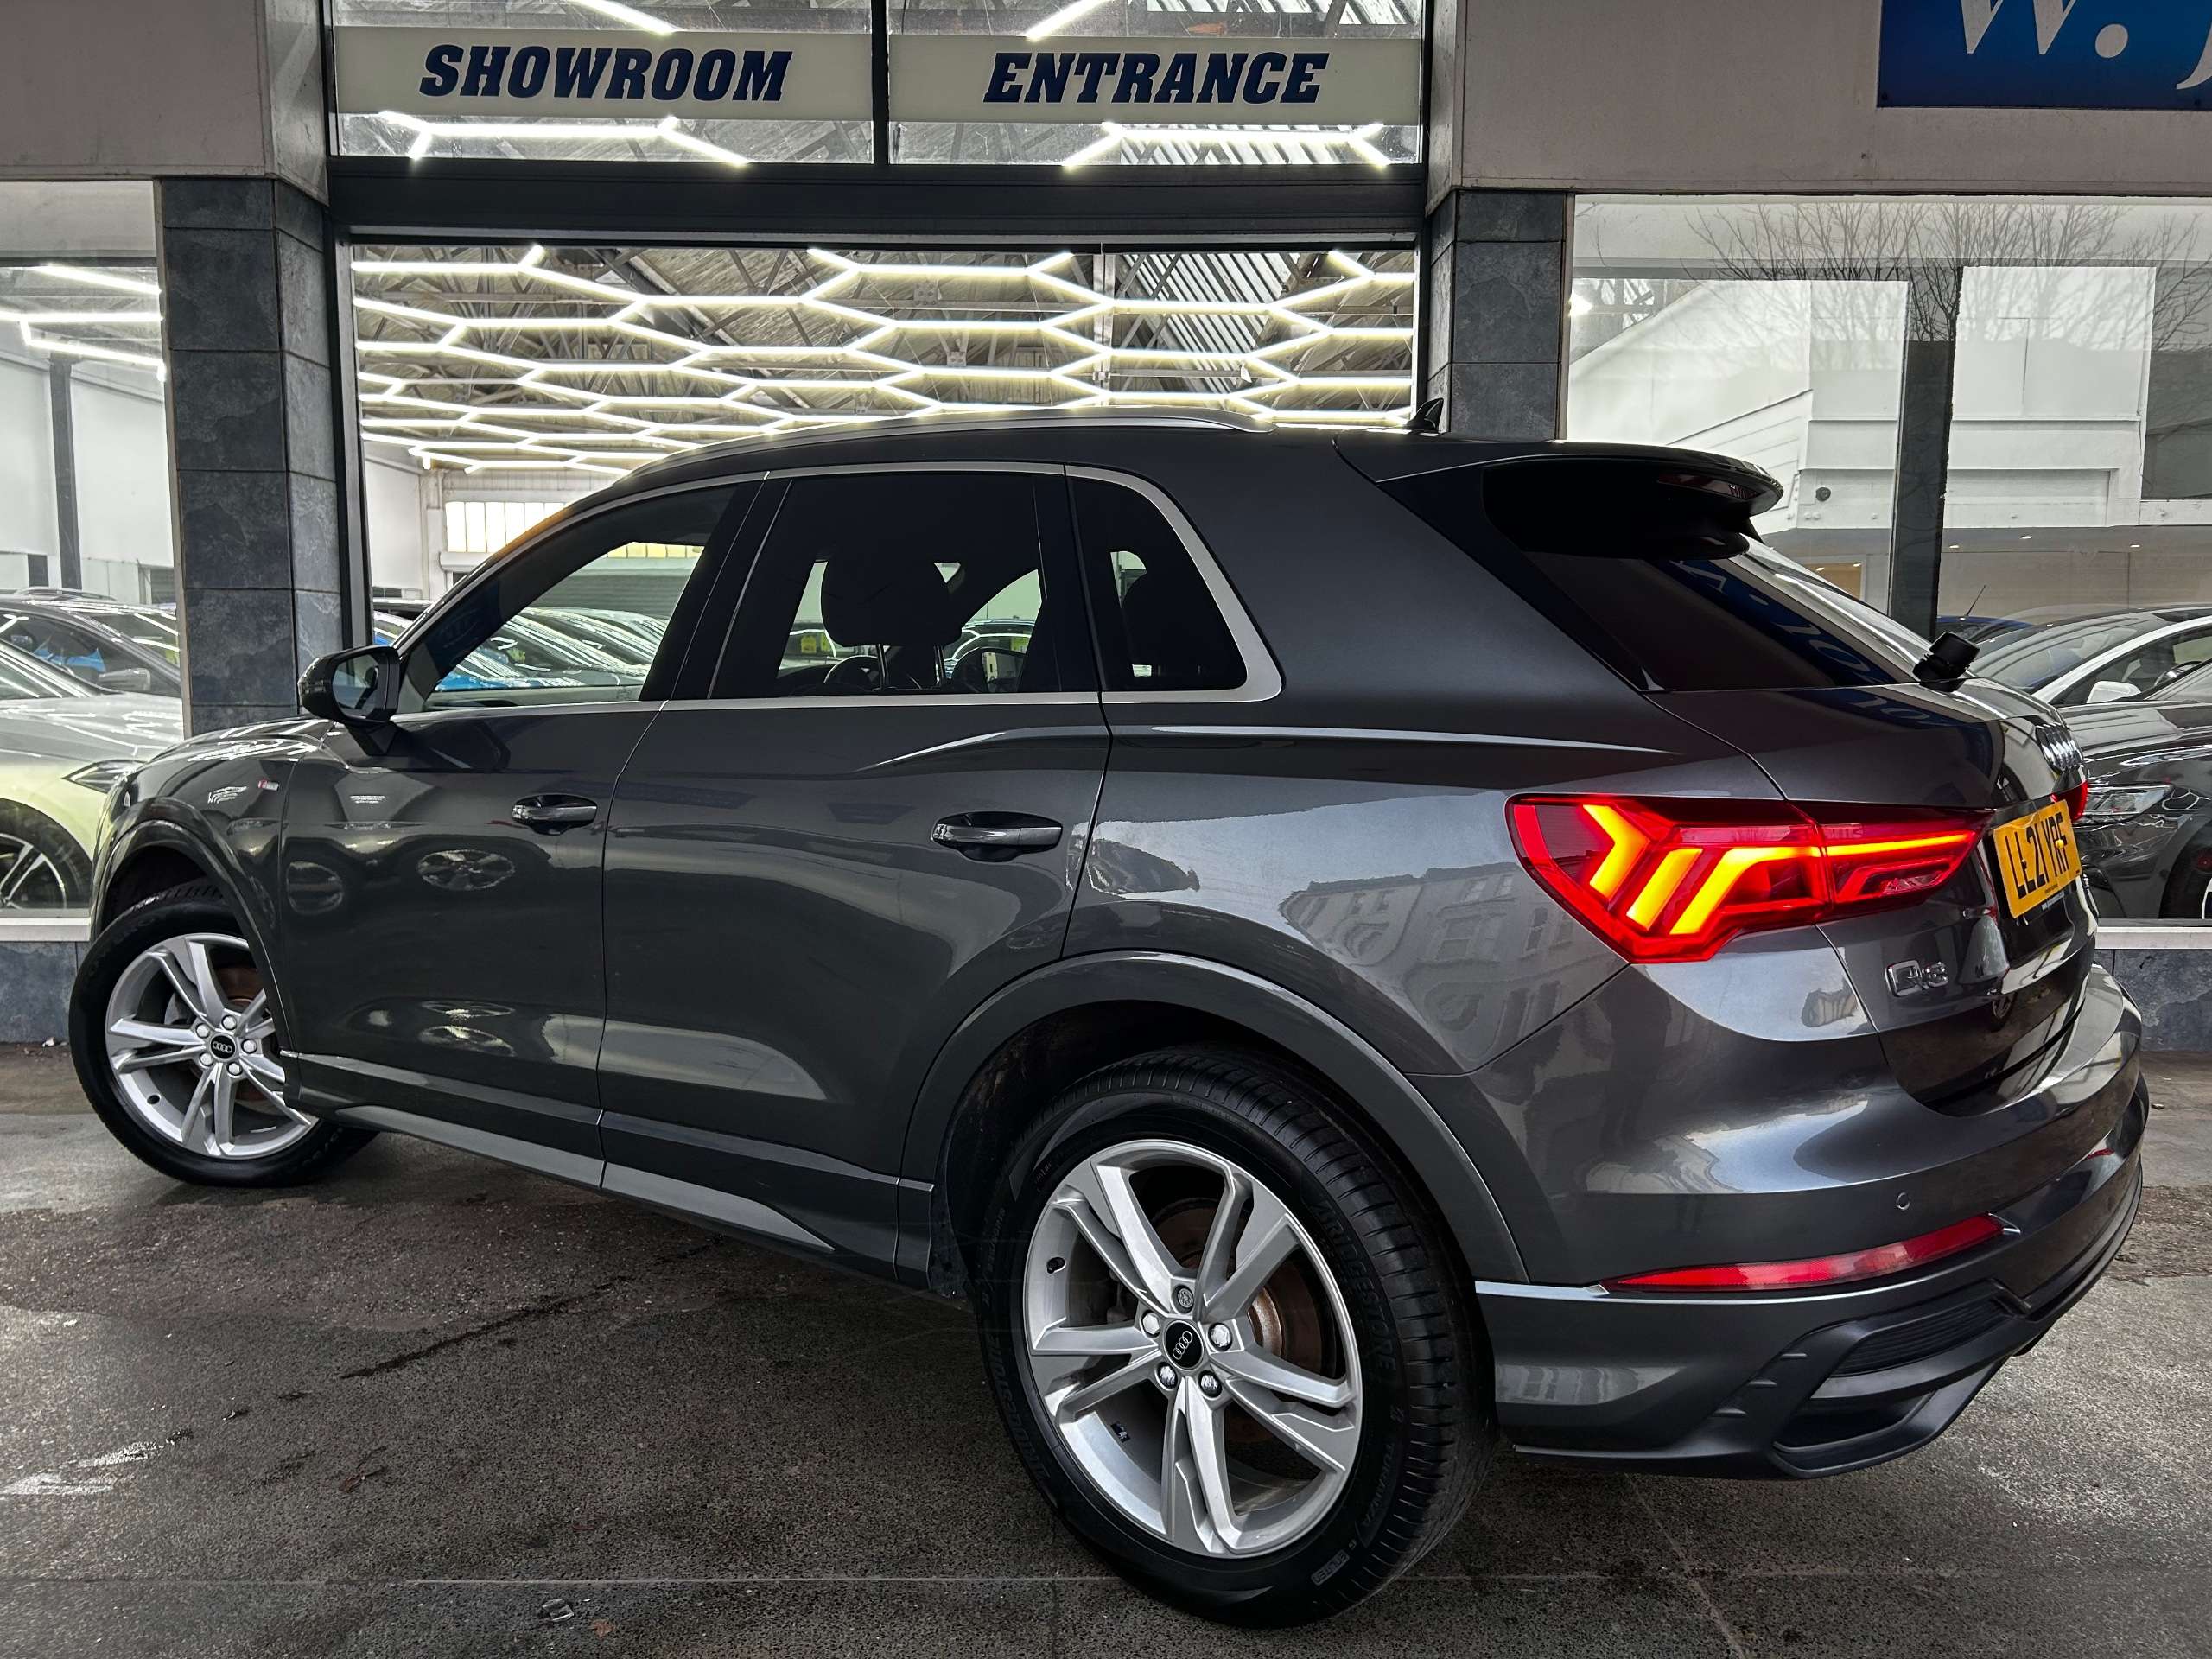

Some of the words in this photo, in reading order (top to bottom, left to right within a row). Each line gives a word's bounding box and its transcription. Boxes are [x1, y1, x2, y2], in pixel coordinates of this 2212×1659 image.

[419, 44, 792, 102] SHOWROOM
[983, 51, 1330, 104] ENTRANCE
[1885, 960, 1948, 995] Q3
